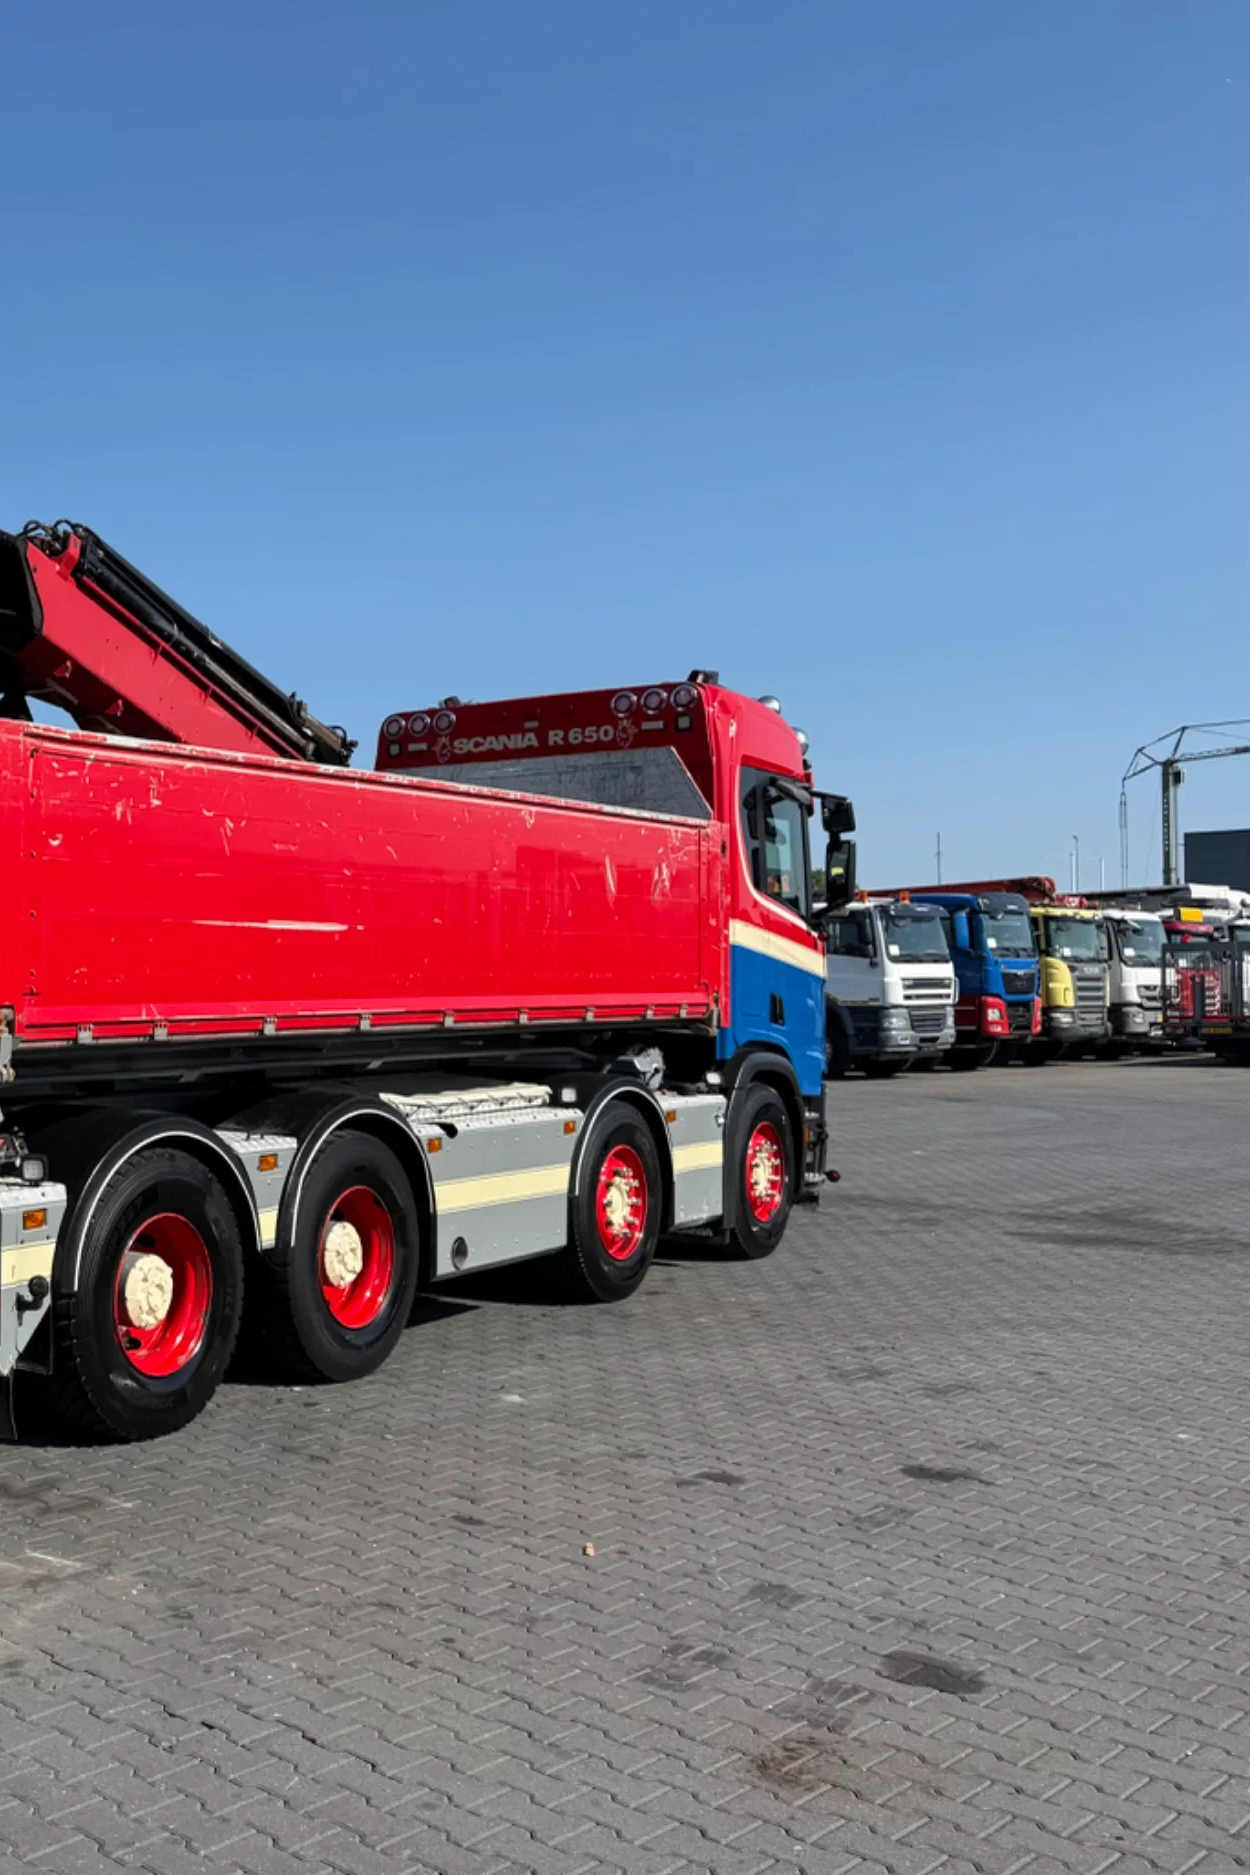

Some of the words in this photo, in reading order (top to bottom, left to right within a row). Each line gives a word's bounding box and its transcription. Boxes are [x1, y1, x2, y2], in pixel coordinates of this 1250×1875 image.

[453, 731, 539, 755] SCANIA
[549, 729, 564, 745] R
[568, 724, 614, 745] 650
